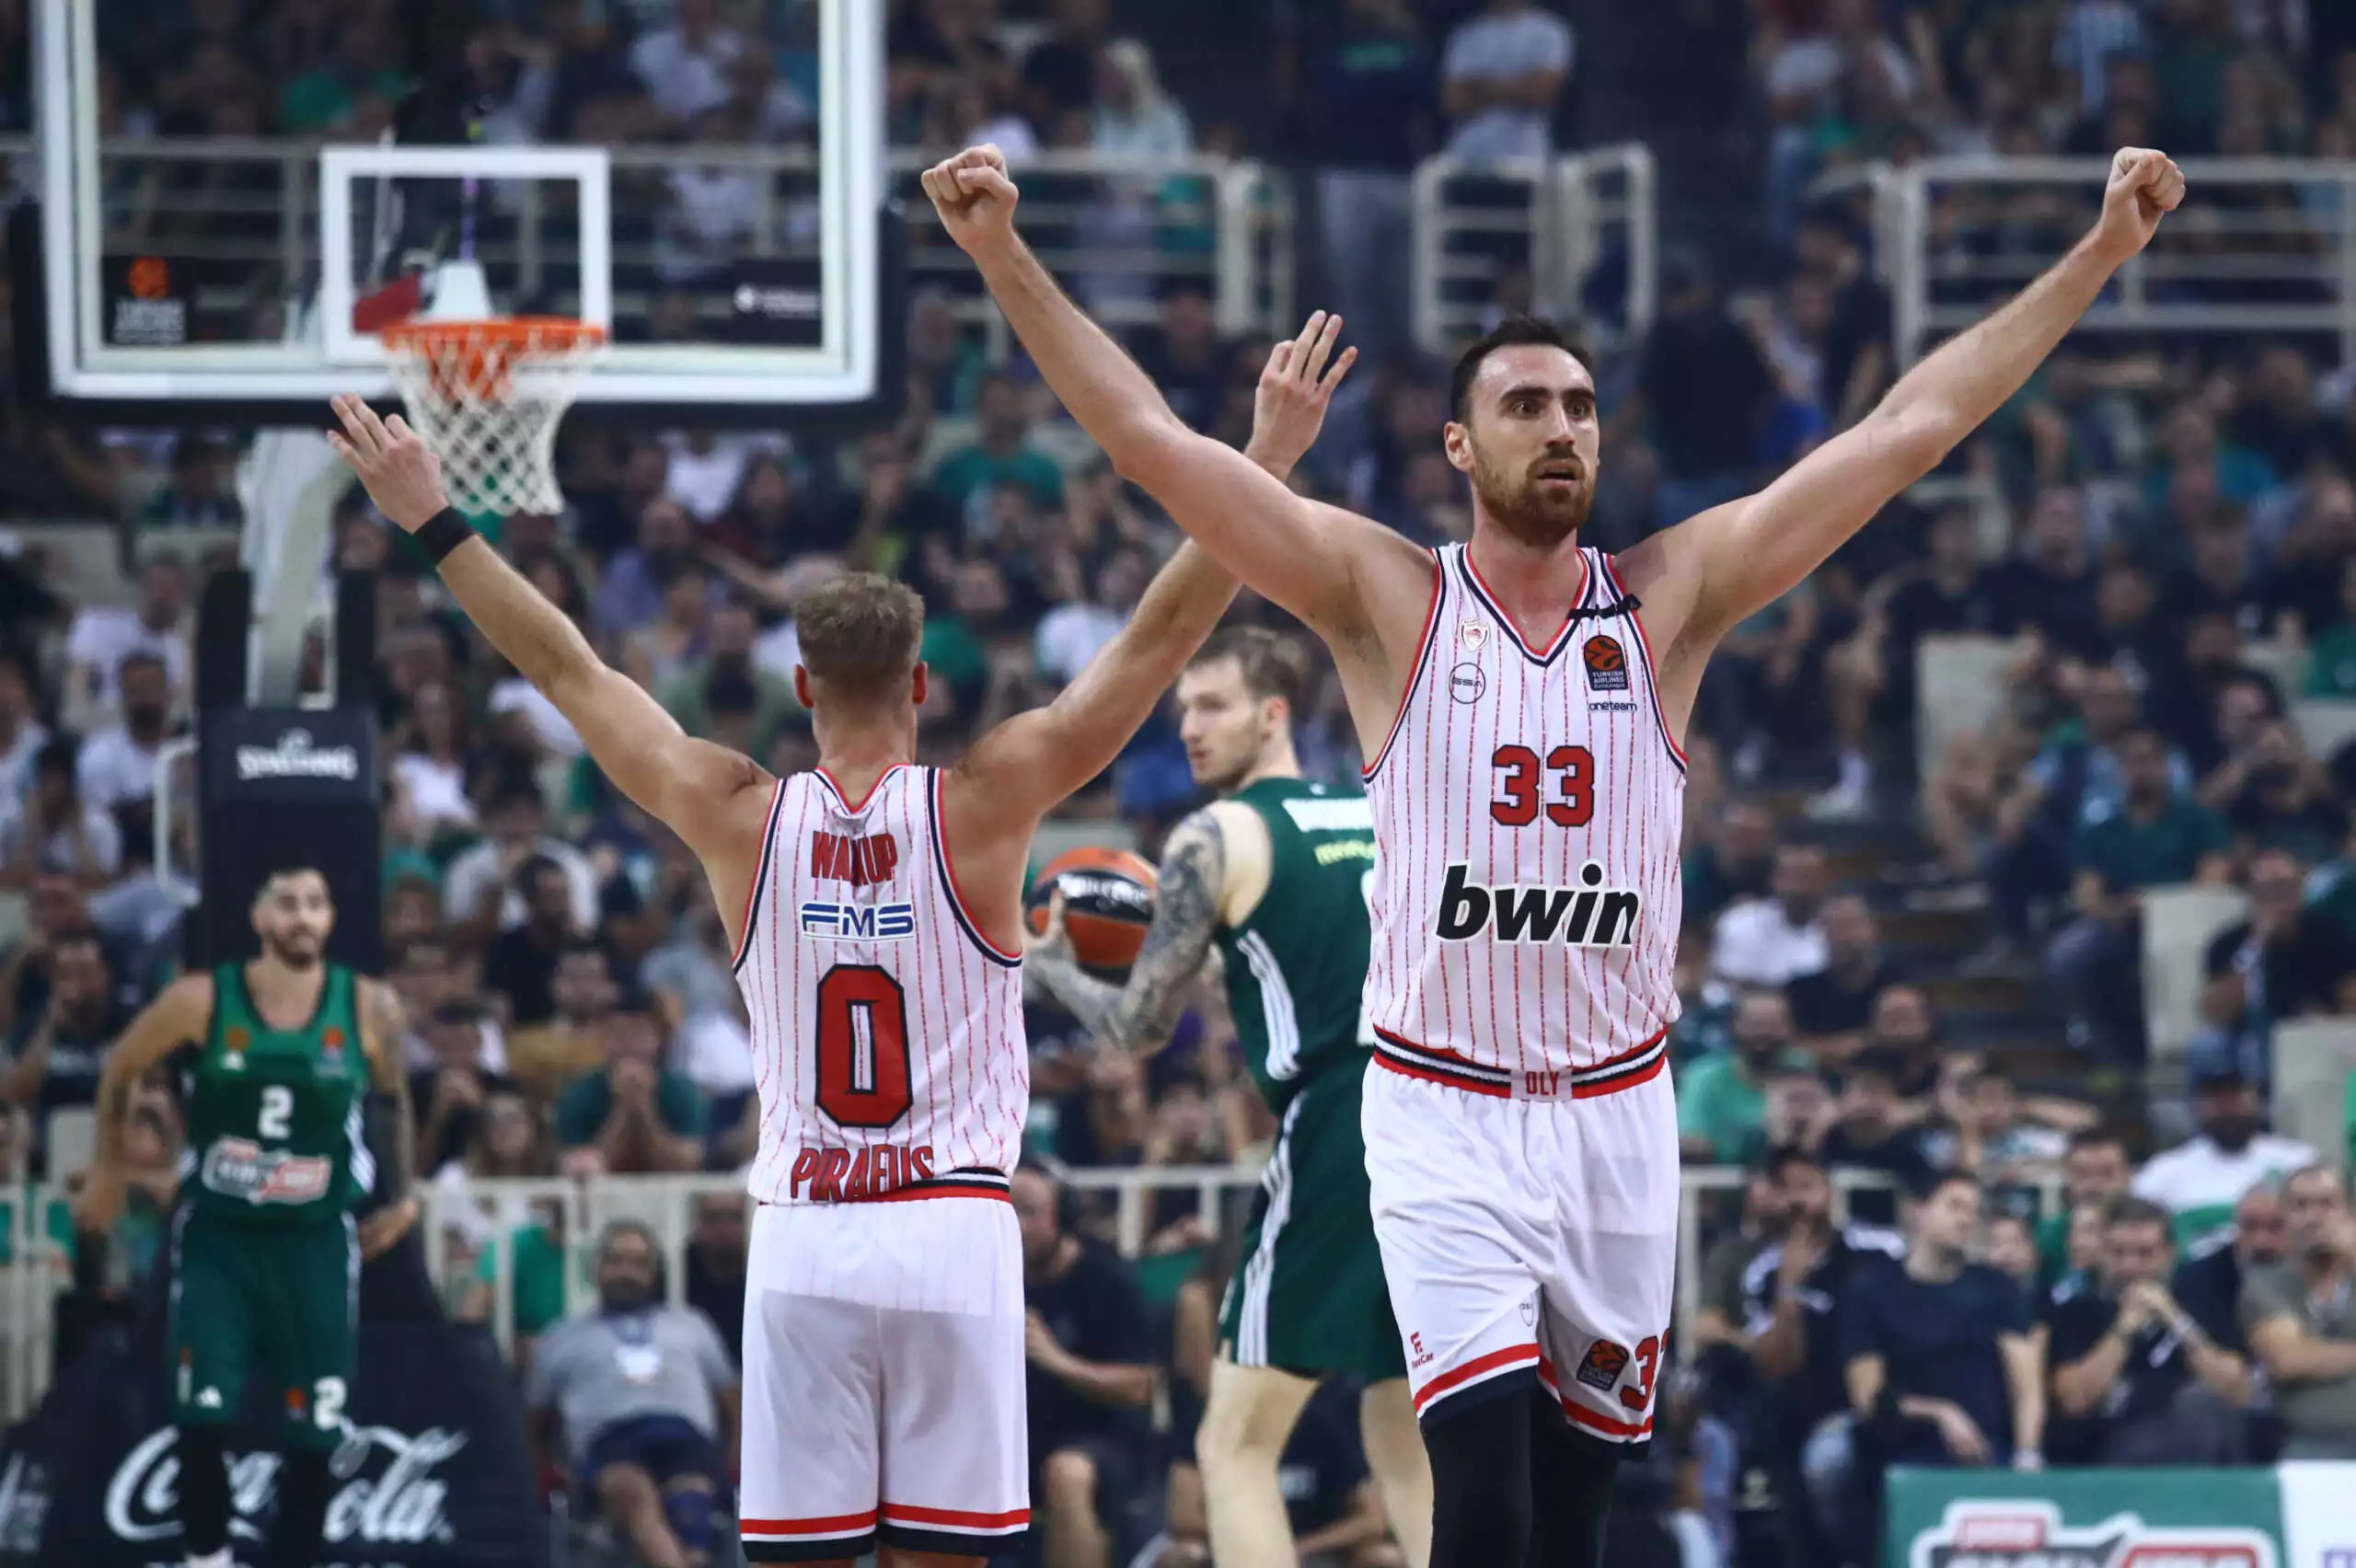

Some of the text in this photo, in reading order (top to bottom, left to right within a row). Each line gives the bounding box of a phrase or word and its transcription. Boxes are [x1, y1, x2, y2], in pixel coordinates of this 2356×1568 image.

[1588, 701, 1638, 713] oneteam
[1489, 744, 1596, 827] 33
[1435, 861, 1640, 946] bwin
[814, 963, 914, 1129] 0
[1526, 1071, 1559, 1095] OLY
[258, 1084, 294, 1139] 2
[313, 1375, 348, 1431] 2
